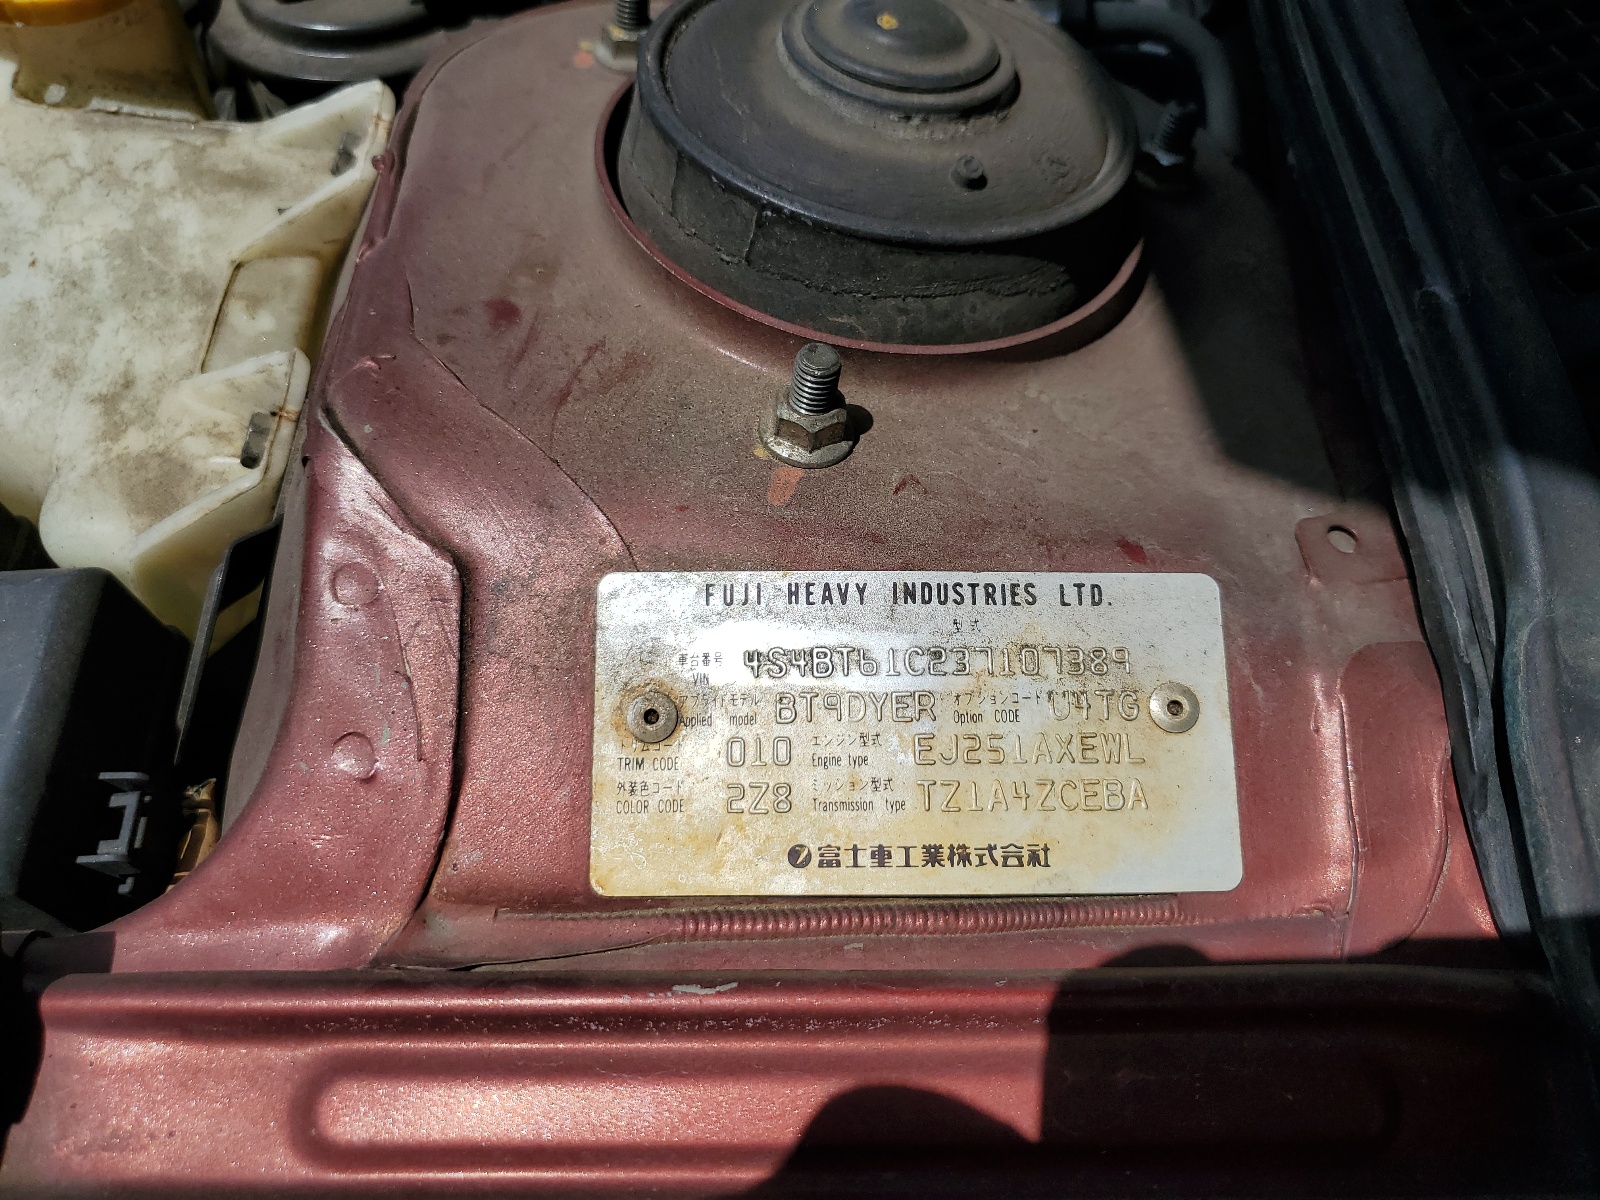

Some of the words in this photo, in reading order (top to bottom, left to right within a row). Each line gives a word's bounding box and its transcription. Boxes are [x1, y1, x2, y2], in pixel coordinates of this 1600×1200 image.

[705, 582, 762, 606] FUJI
[787, 582, 867, 605] HEAVY
[892, 581, 1038, 606] INDUSTRIES
[1059, 583, 1112, 607] LTD.
[678, 651, 724, 667] 車台番号
[743, 646, 1132, 679] 4S4BT61C237107389
[692, 672, 710, 687] VIN
[775, 690, 937, 725] BT9DYER
[729, 712, 757, 726] model
[953, 709, 983, 726] Option
[994, 709, 1020, 723] CODE
[812, 732, 883, 748] エンジン型式
[913, 731, 1146, 766] EJ251AXEWL
[726, 736, 792, 768] 010
[617, 757, 645, 772] TRIM
[652, 756, 680, 771] CODE
[811, 753, 842, 770] Engine
[848, 754, 869, 769] type
[812, 776, 895, 792] ミッション型式
[726, 781, 792, 815] 2Z8
[916, 777, 1149, 812] TZ1A4ZCEBA
[616, 799, 650, 815] COLOR
[658, 798, 685, 814] CODE
[812, 797, 874, 812] Transmission
[885, 798, 906, 814] type
[817, 842, 1051, 869] 富士重工業株式会社
